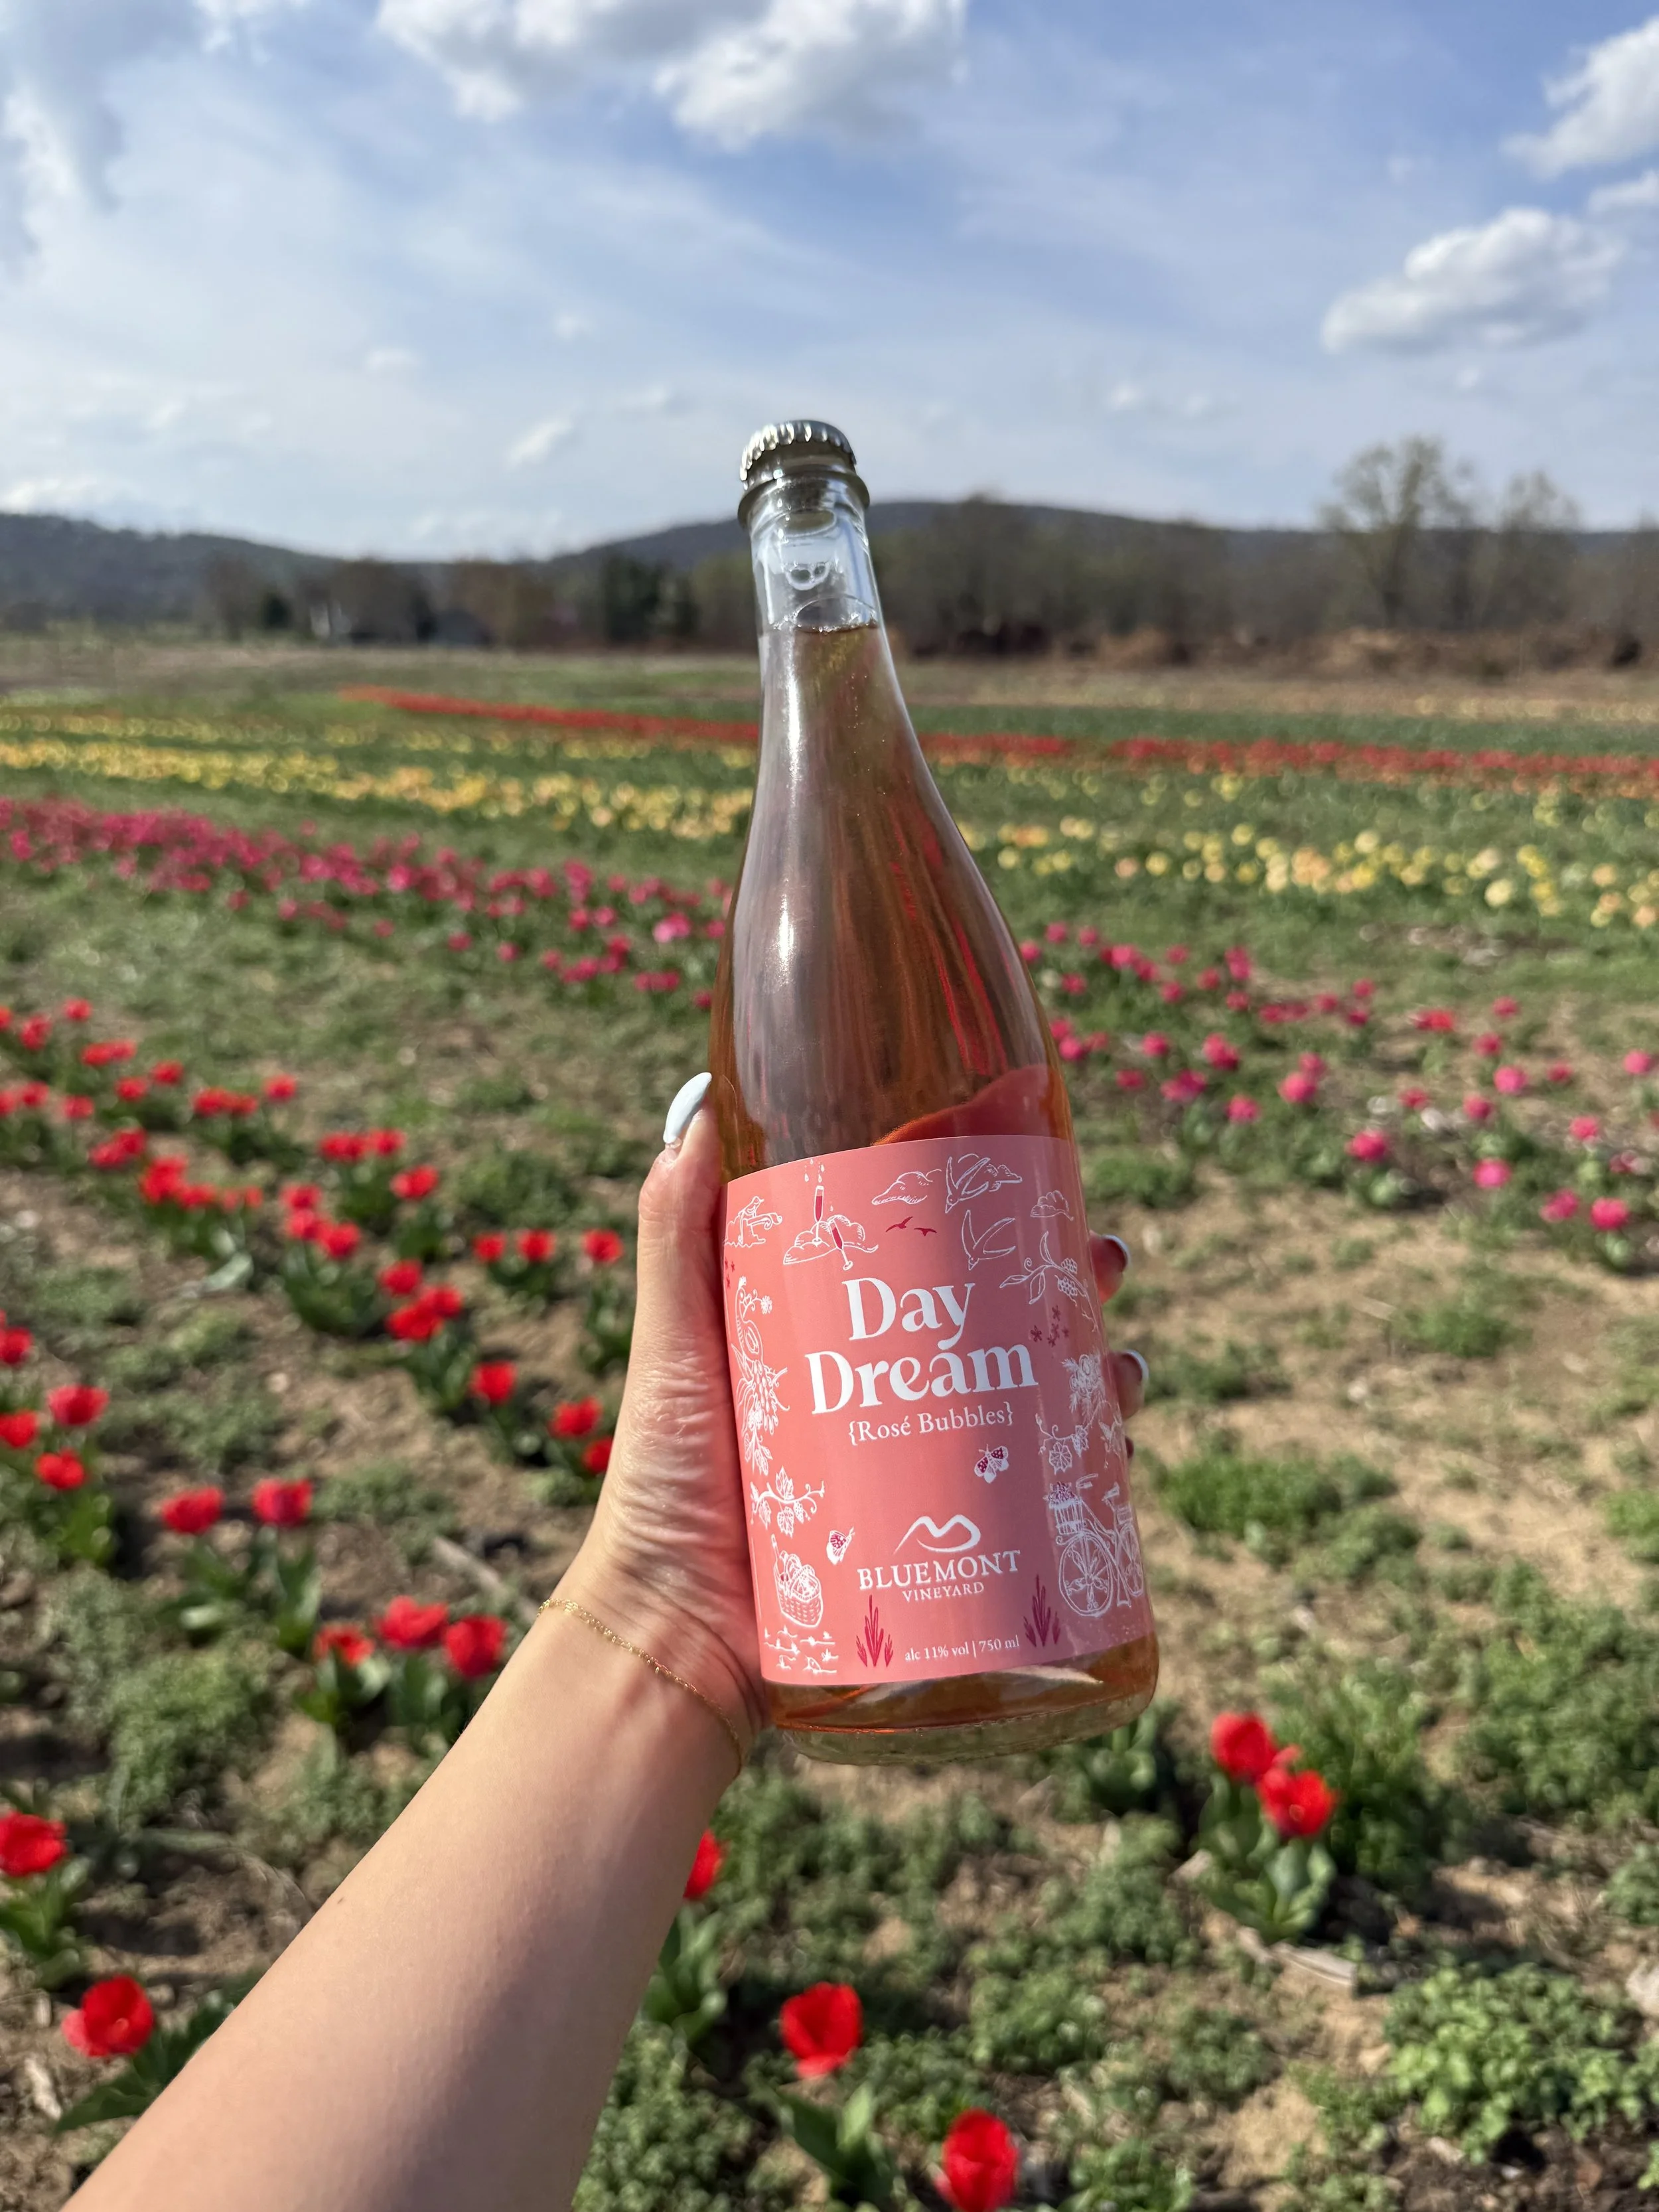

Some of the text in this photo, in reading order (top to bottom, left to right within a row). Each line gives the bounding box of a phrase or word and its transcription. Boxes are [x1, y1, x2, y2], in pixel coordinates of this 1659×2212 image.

[841, 1277, 975, 1350] Day
[804, 1343, 1039, 1415] Dream
[848, 1401, 1014, 1445] {Rosé Bubbles}
[857, 1550, 1021, 1590] BLUEMONT
[902, 1581, 985, 1603] VINEYARD
[904, 1648, 920, 1662] alc
[923, 1646, 949, 1660] 11%
[952, 1642, 970, 1657] vol
[978, 1639, 1001, 1653] 750
[1004, 1635, 1020, 1649] ml
